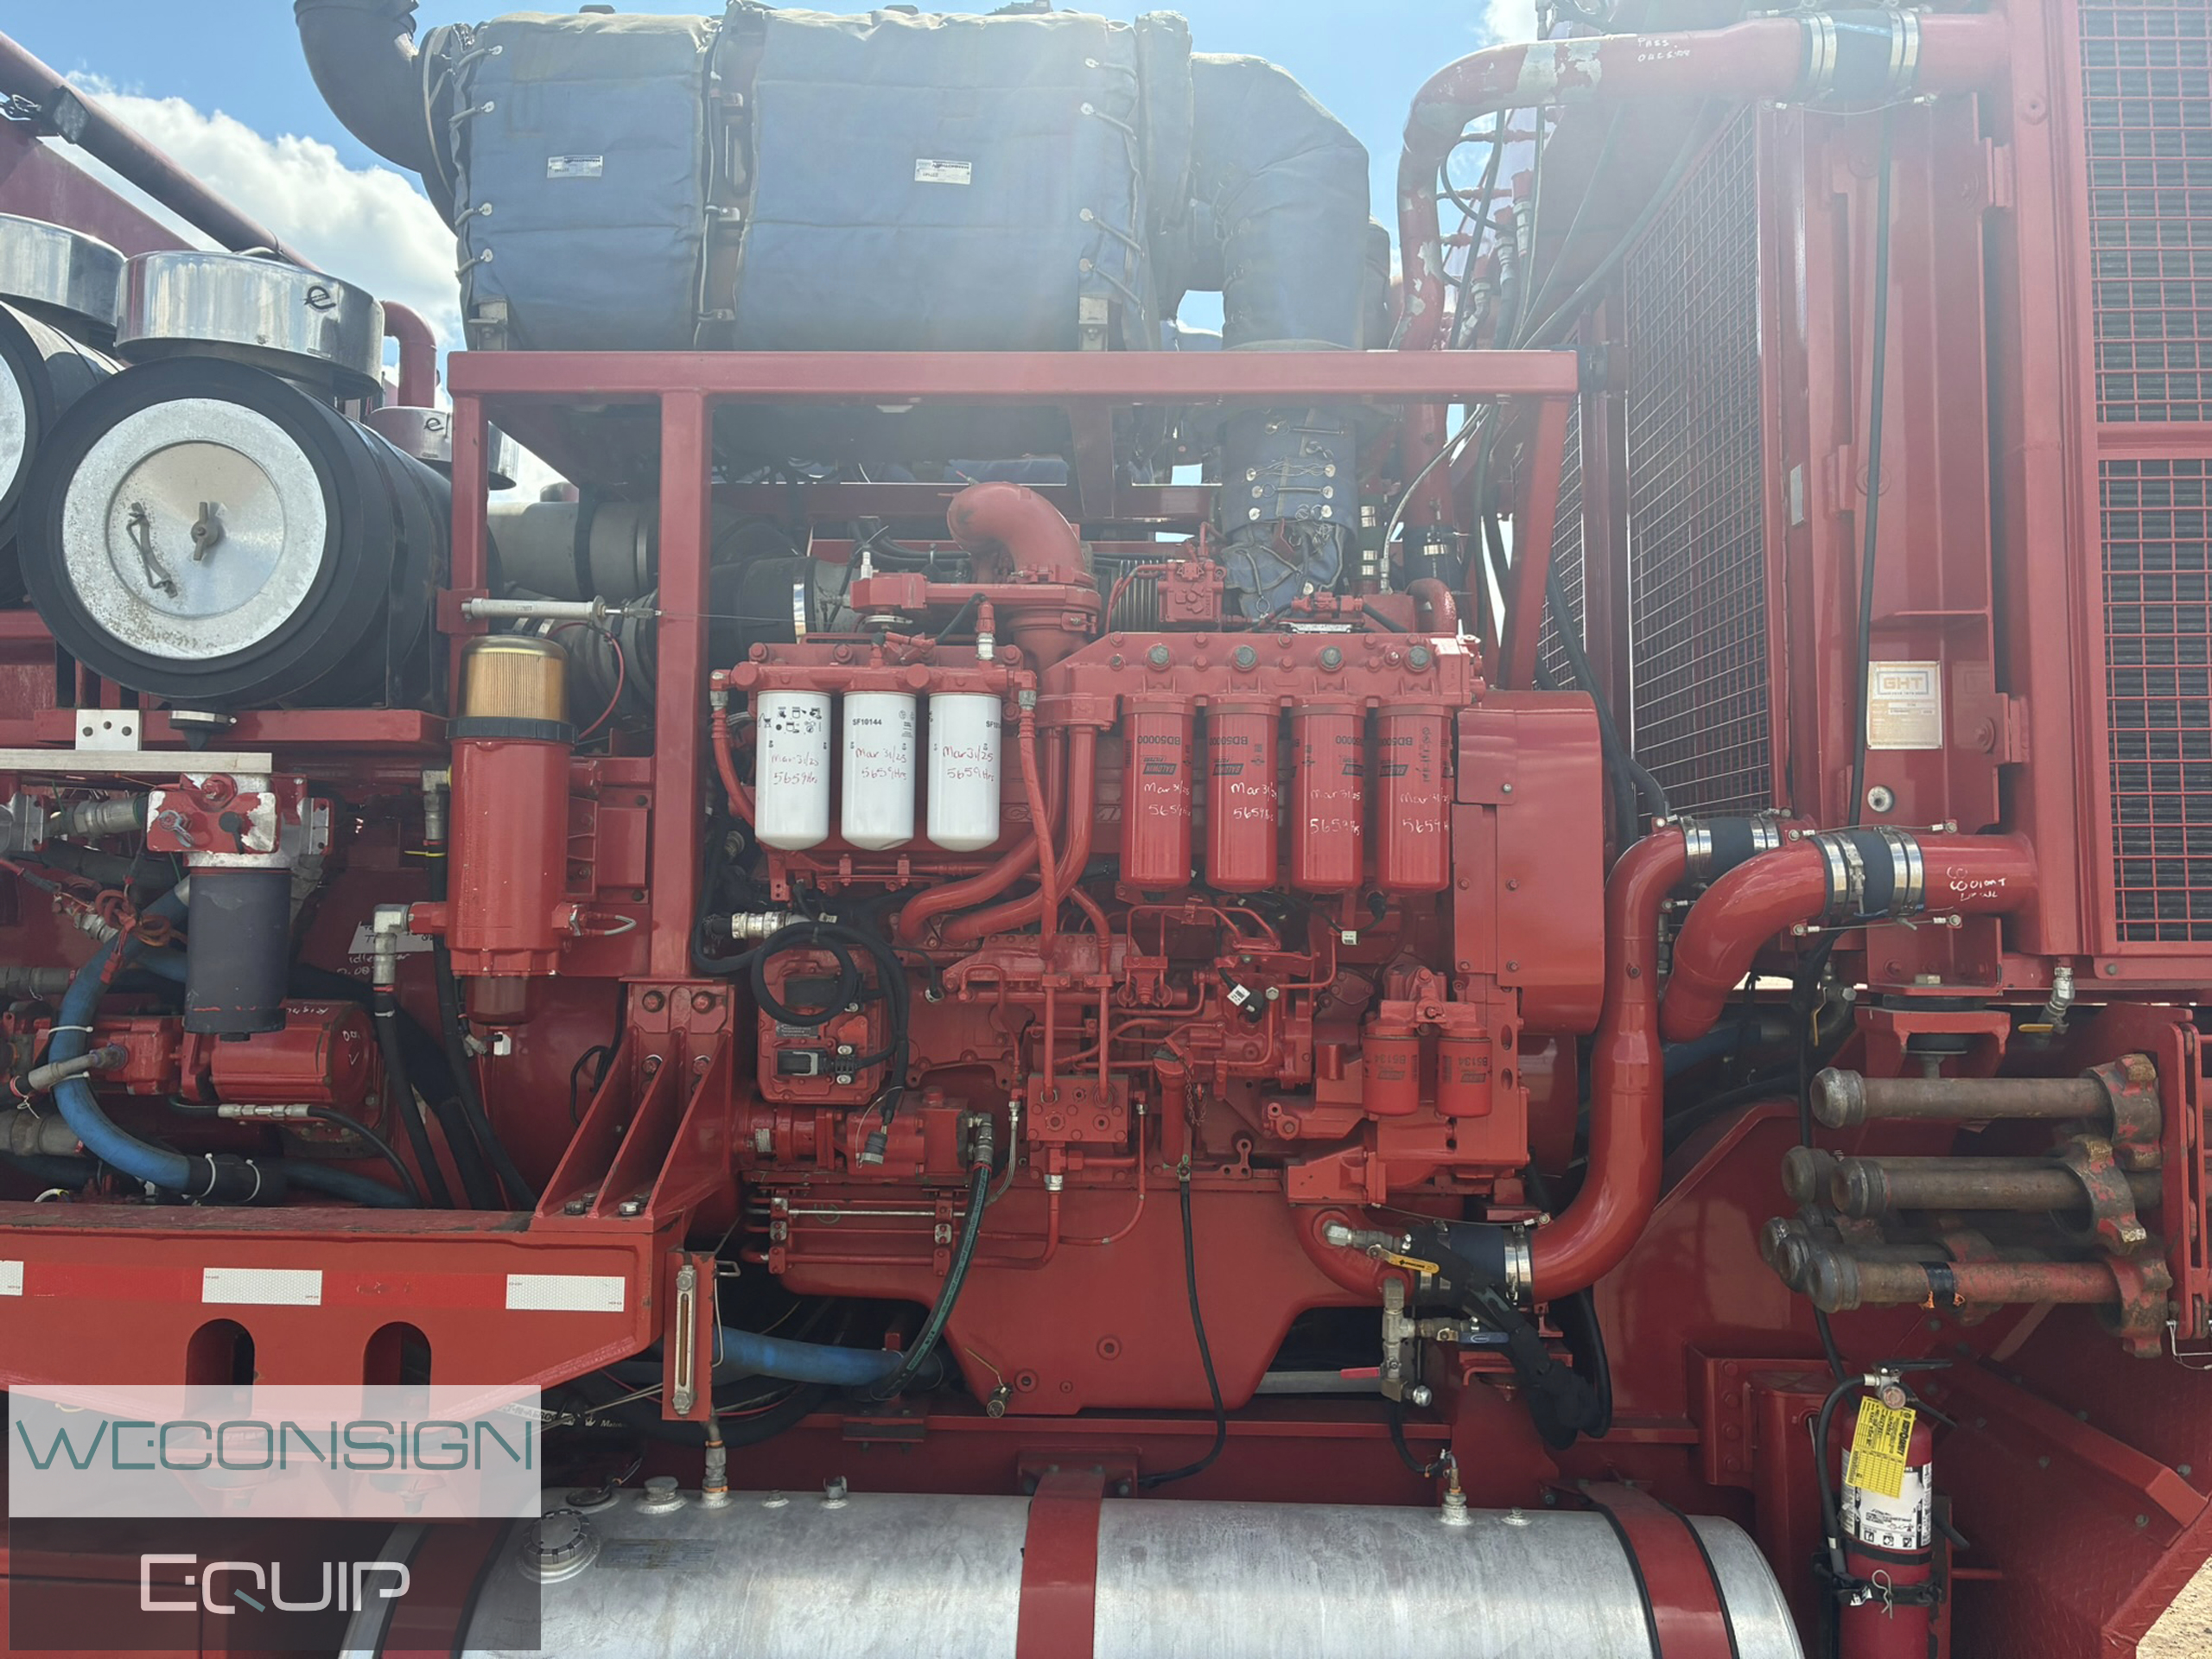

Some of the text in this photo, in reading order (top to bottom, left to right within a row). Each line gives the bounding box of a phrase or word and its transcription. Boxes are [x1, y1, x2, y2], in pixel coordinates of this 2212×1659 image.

[1137, 735, 1181, 746] BD50000
[943, 746, 966, 759] Mar
[1144, 782, 1171, 794] Mar
[1230, 781, 1261, 796] Mar
